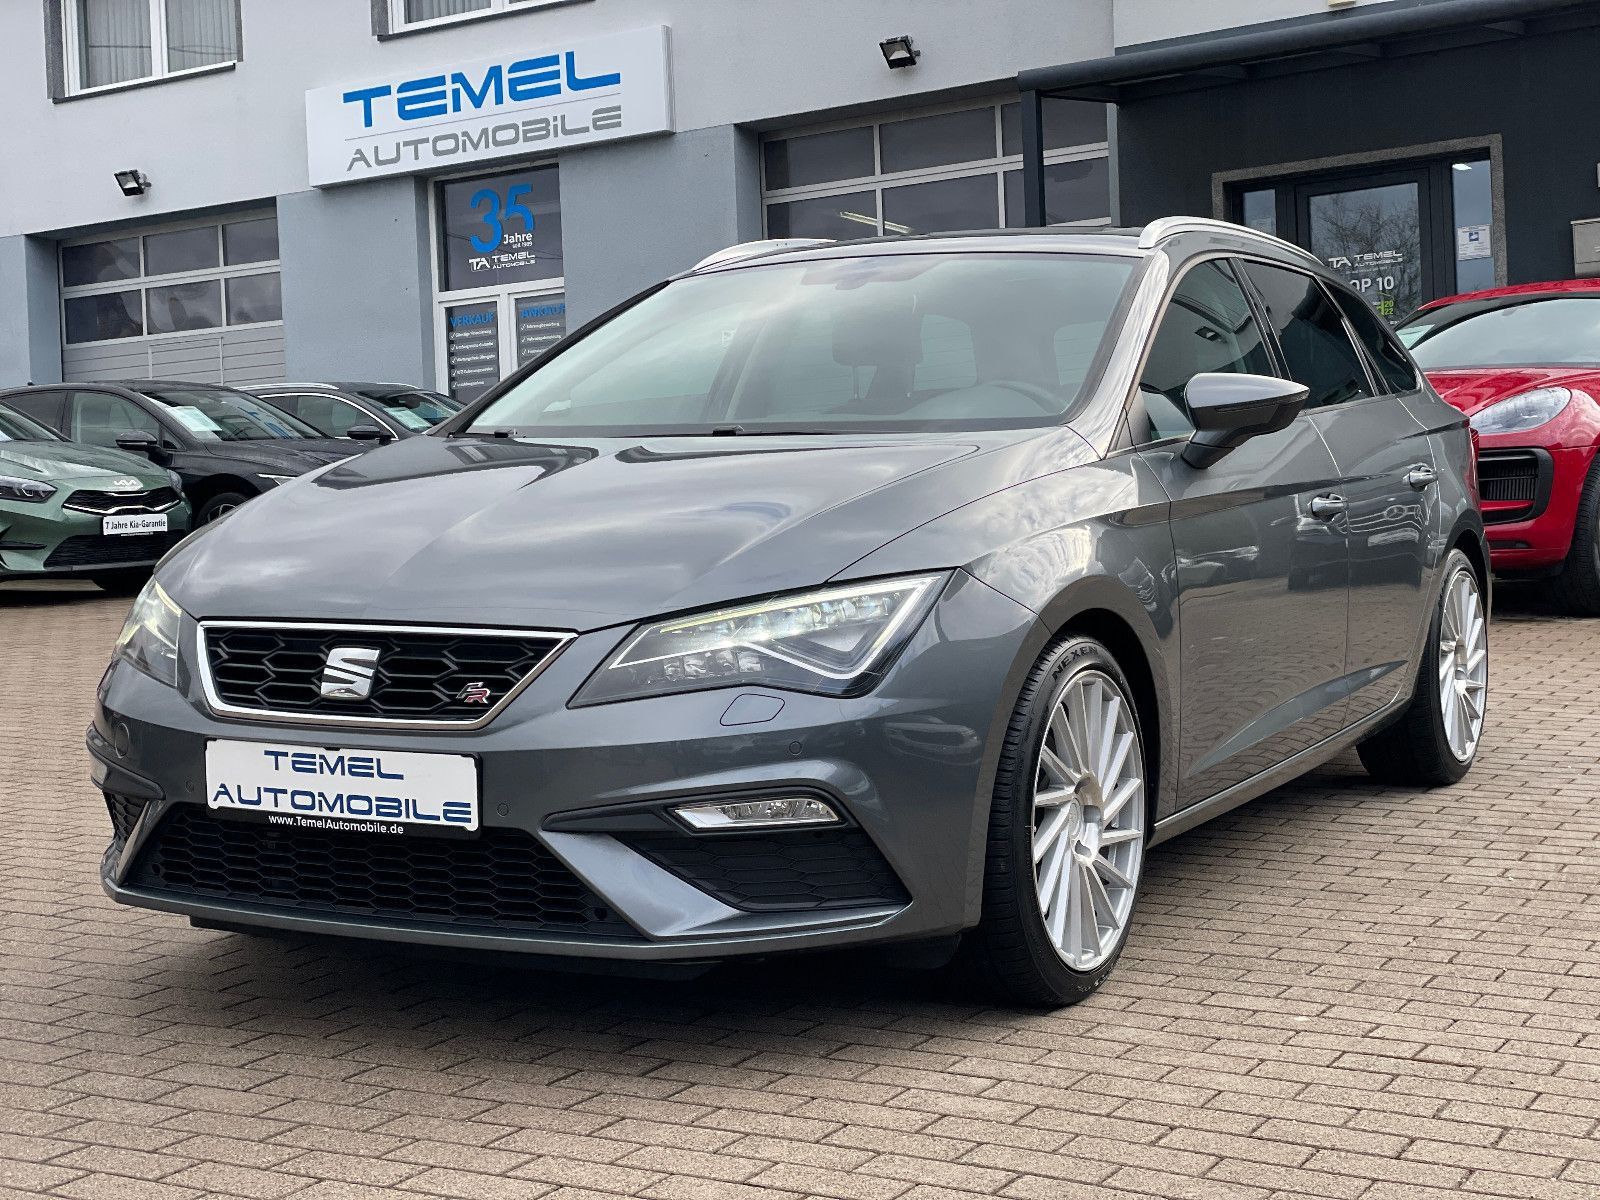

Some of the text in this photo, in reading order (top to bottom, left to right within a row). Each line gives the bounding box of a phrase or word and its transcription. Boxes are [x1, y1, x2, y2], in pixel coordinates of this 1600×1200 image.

[343, 51, 620, 127] TEMEL
[470, 184, 534, 254] 35
[503, 232, 533, 245] Jahre
[492, 251, 536, 263] TEMEL
[1353, 250, 1403, 261] TEMEL
[468, 257, 490, 270] TA
[1328, 256, 1352, 269] TA
[1349, 275, 1395, 293] OP 10
[1384, 300, 1394, 308] 20
[1384, 308, 1394, 316] 22
[450, 313, 494, 326] VERKAUF
[105, 518, 166, 530] 7 Jahre Kia-Garantie
[1051, 645, 1099, 682] NEXEN
[263, 750, 405, 780] TEMEL
[212, 783, 472, 823] AUTOMOBILE
[268, 814, 404, 835] www.TemelAutomobile.de
